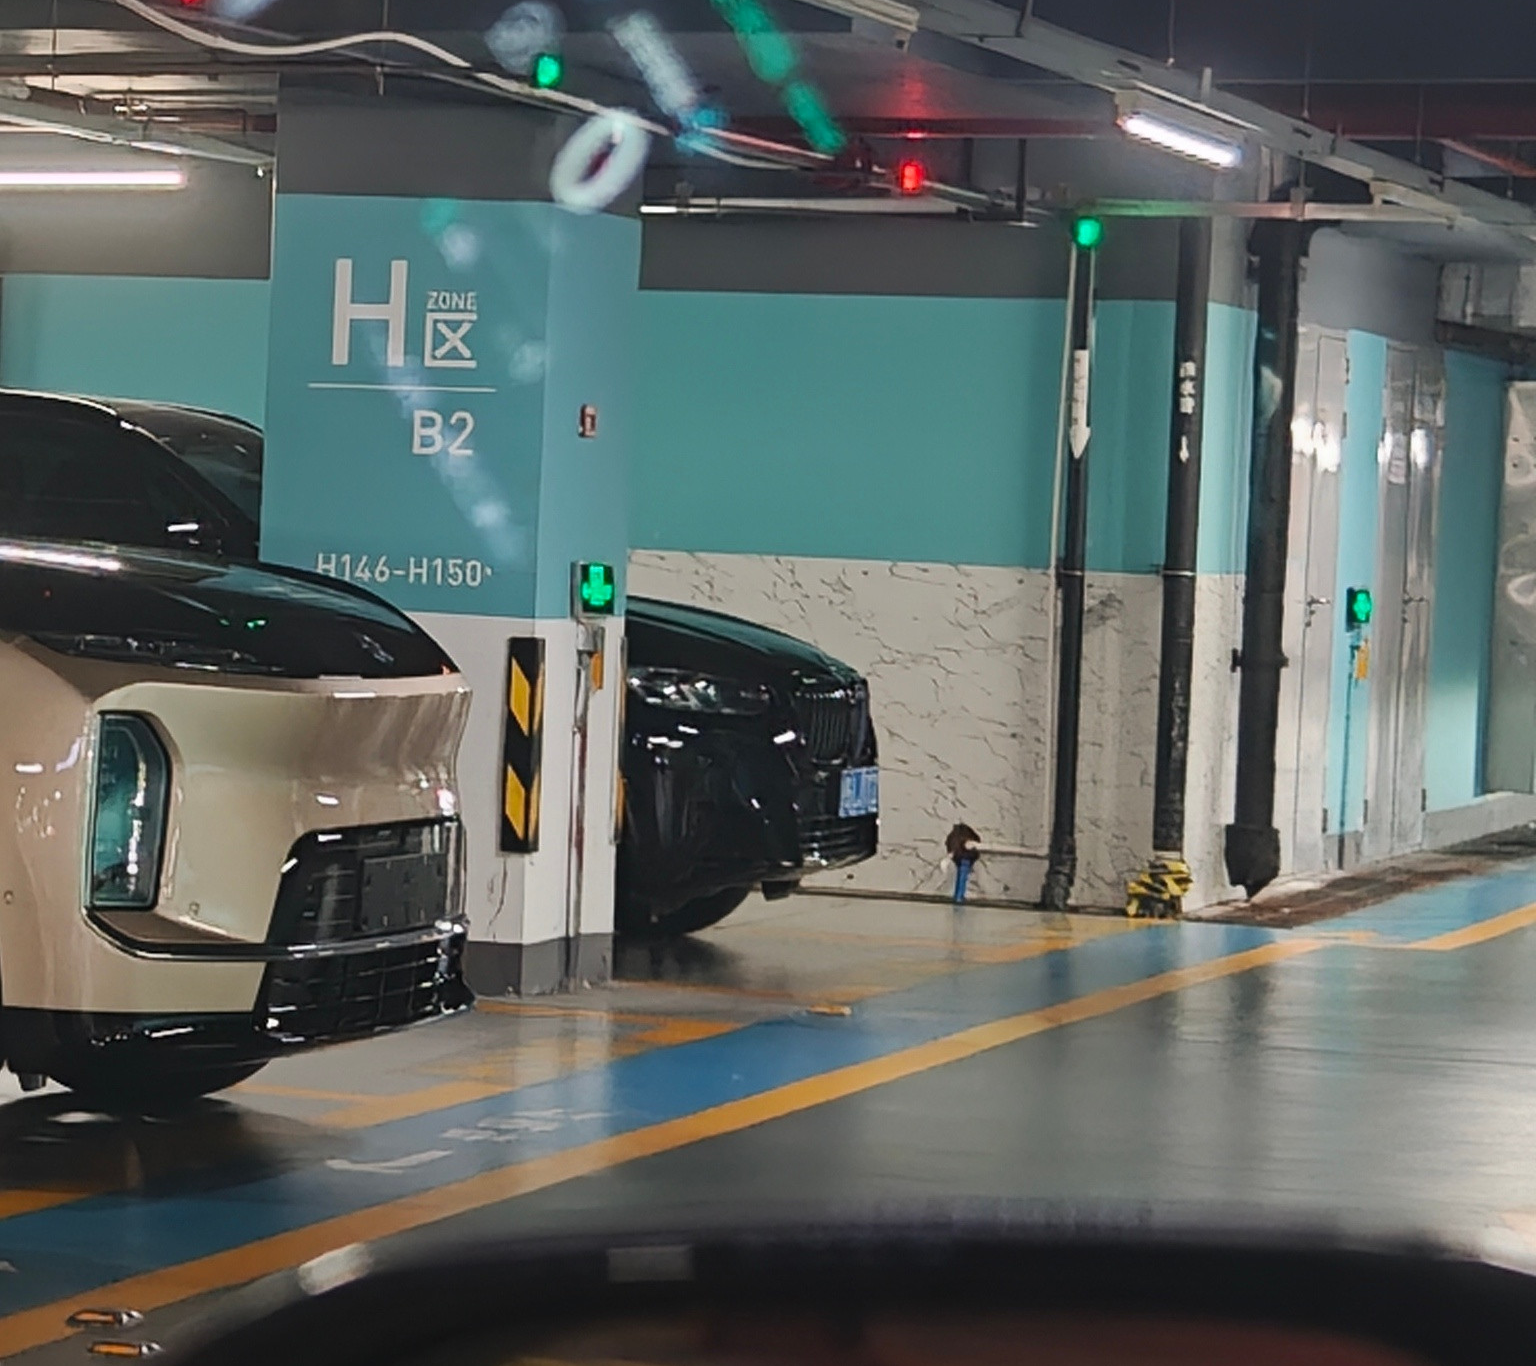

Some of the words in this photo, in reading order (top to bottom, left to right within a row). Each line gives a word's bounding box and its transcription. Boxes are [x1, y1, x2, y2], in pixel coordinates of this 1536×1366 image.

[331, 258, 408, 367] H
[426, 291, 477, 310] ZONE
[424, 312, 477, 368] 区
[412, 410, 474, 456] B2
[317, 552, 482, 587] H146-H150
